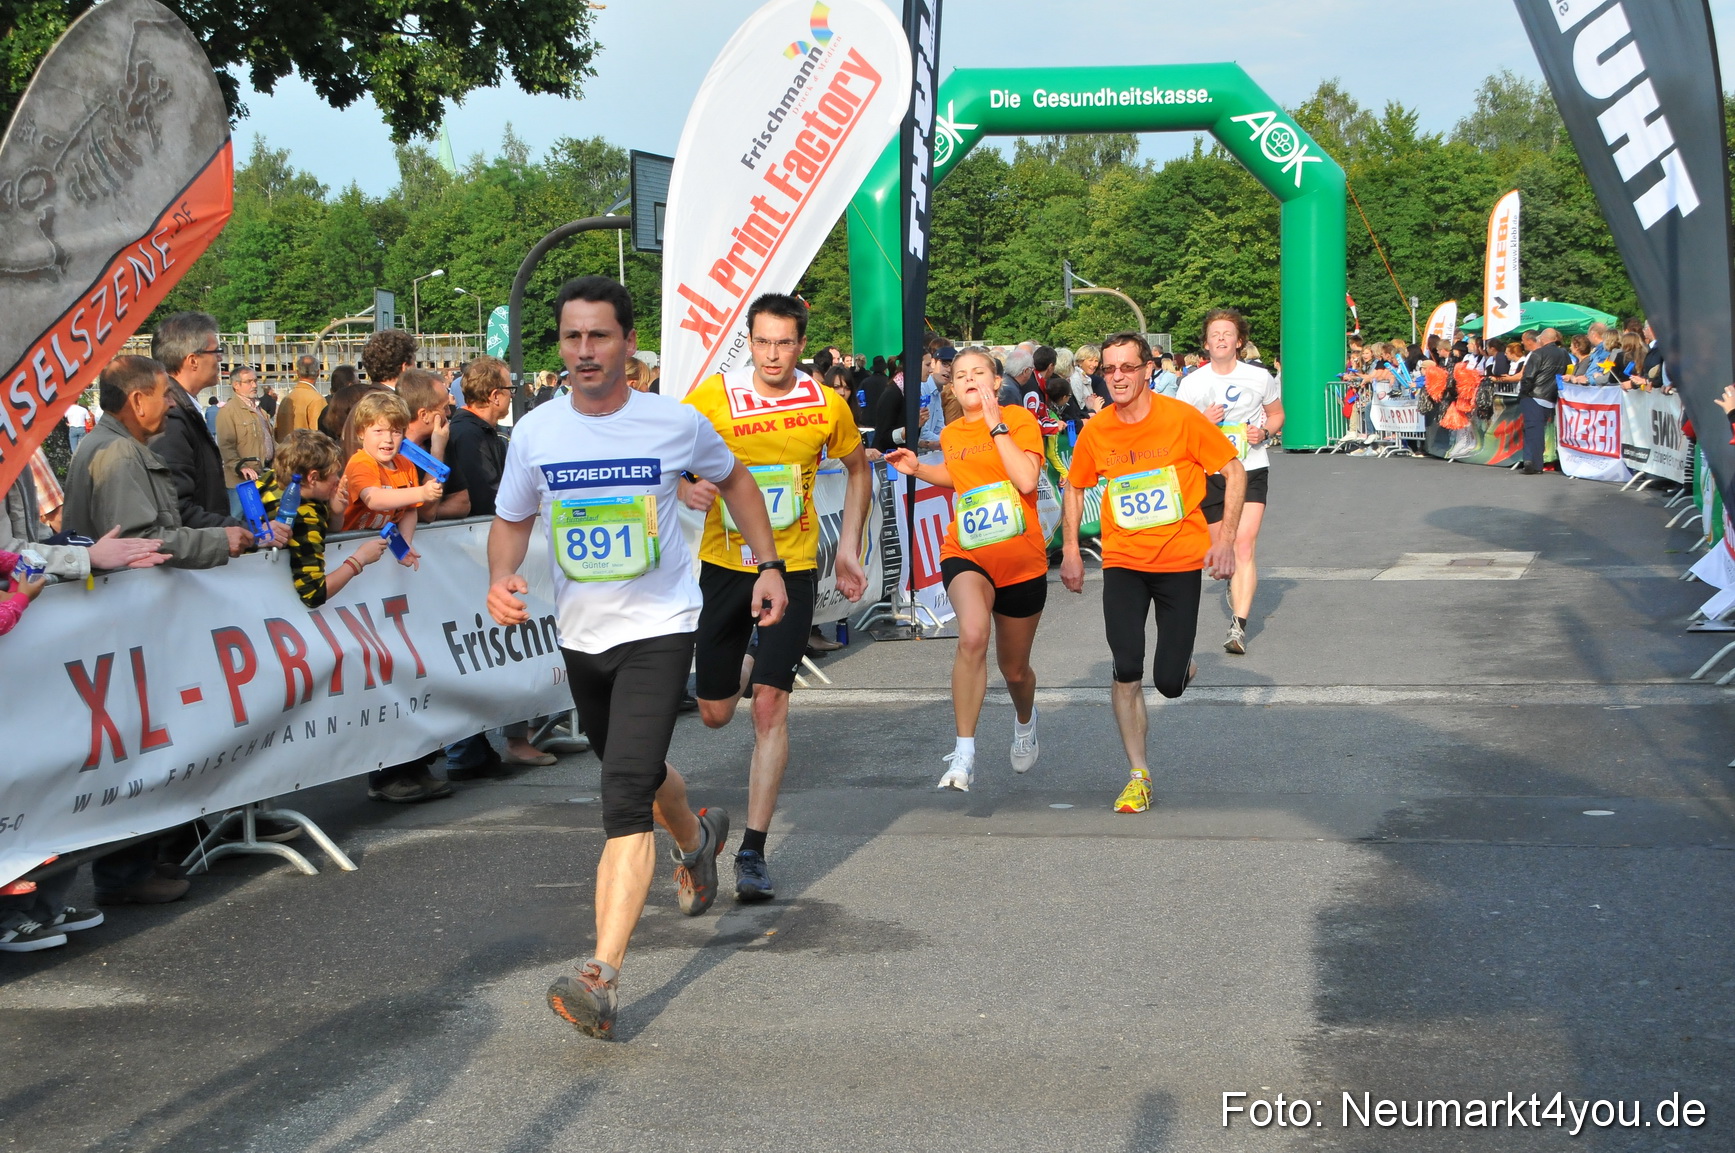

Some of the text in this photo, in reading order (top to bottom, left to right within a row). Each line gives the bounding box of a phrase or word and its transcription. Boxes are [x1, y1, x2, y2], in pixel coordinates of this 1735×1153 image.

[740, 46, 823, 171] Frischmann
[989, 86, 1213, 109] Die Gesundheitskasse.
[1230, 110, 1323, 188] AOK
[707, 194, 791, 299] Print
[763, 46, 883, 203] Factory
[1495, 207, 1510, 291] KLEBL
[733, 412, 829, 438] MAX BÖGL
[1561, 404, 1617, 454] MEIER
[557, 465, 653, 483] STAEDTLER
[1106, 447, 1169, 467] EURO POLES
[963, 502, 1009, 534] 624
[1120, 488, 1168, 517] 582
[566, 524, 632, 561] 891
[581, 561, 610, 570] Günter
[64, 594, 427, 773] XL-PRINT
